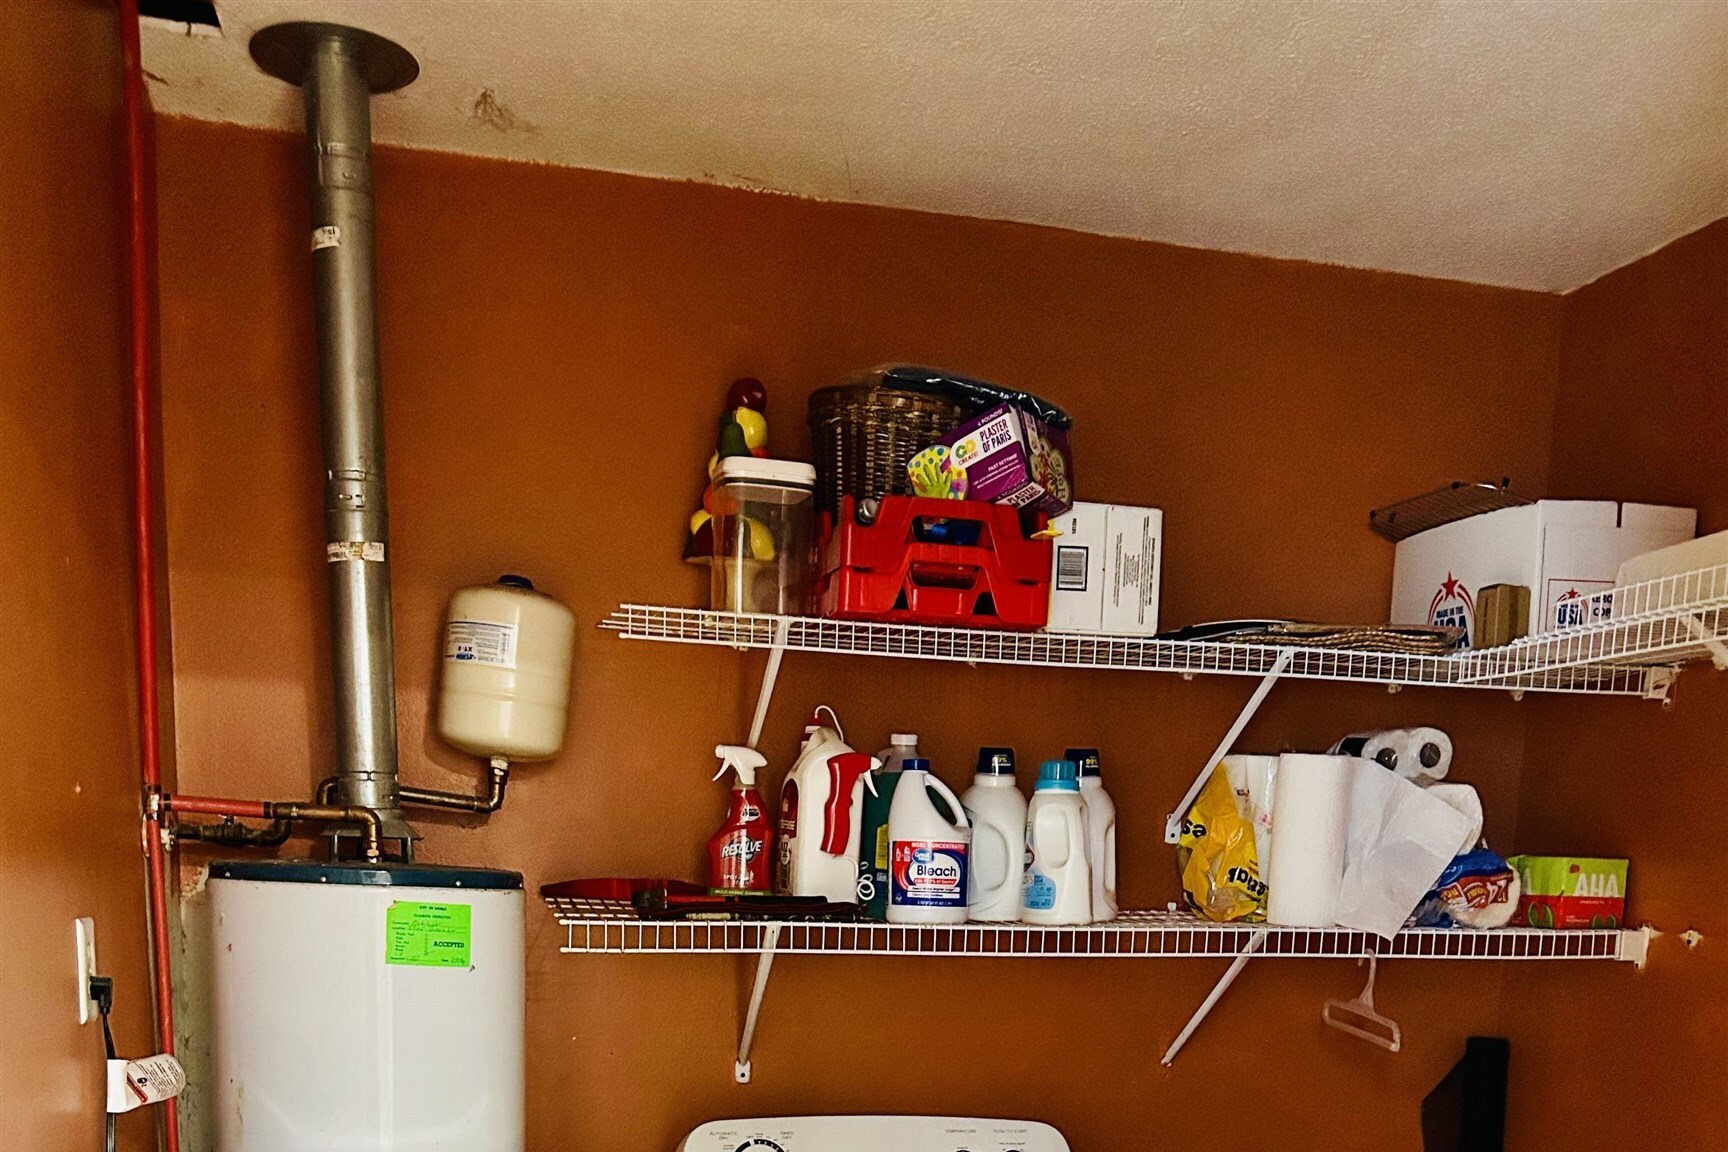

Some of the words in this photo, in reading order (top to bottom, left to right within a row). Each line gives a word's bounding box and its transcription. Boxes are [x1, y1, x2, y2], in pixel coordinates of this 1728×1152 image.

[980, 418, 1009, 442] PLASTER
[982, 441, 991, 454] OF
[990, 430, 1012, 451] PARIS
[1007, 483, 1037, 505] PLASTER
[1436, 609, 1449, 618] MADE
[1449, 607, 1455, 616] IN
[1455, 605, 1464, 615] THE
[1557, 606, 1583, 625] USA
[721, 840, 763, 858] RESOLVE
[916, 865, 957, 877] Bleach
[1575, 872, 1619, 897] AHA
[433, 940, 465, 949] ACCEPTED
